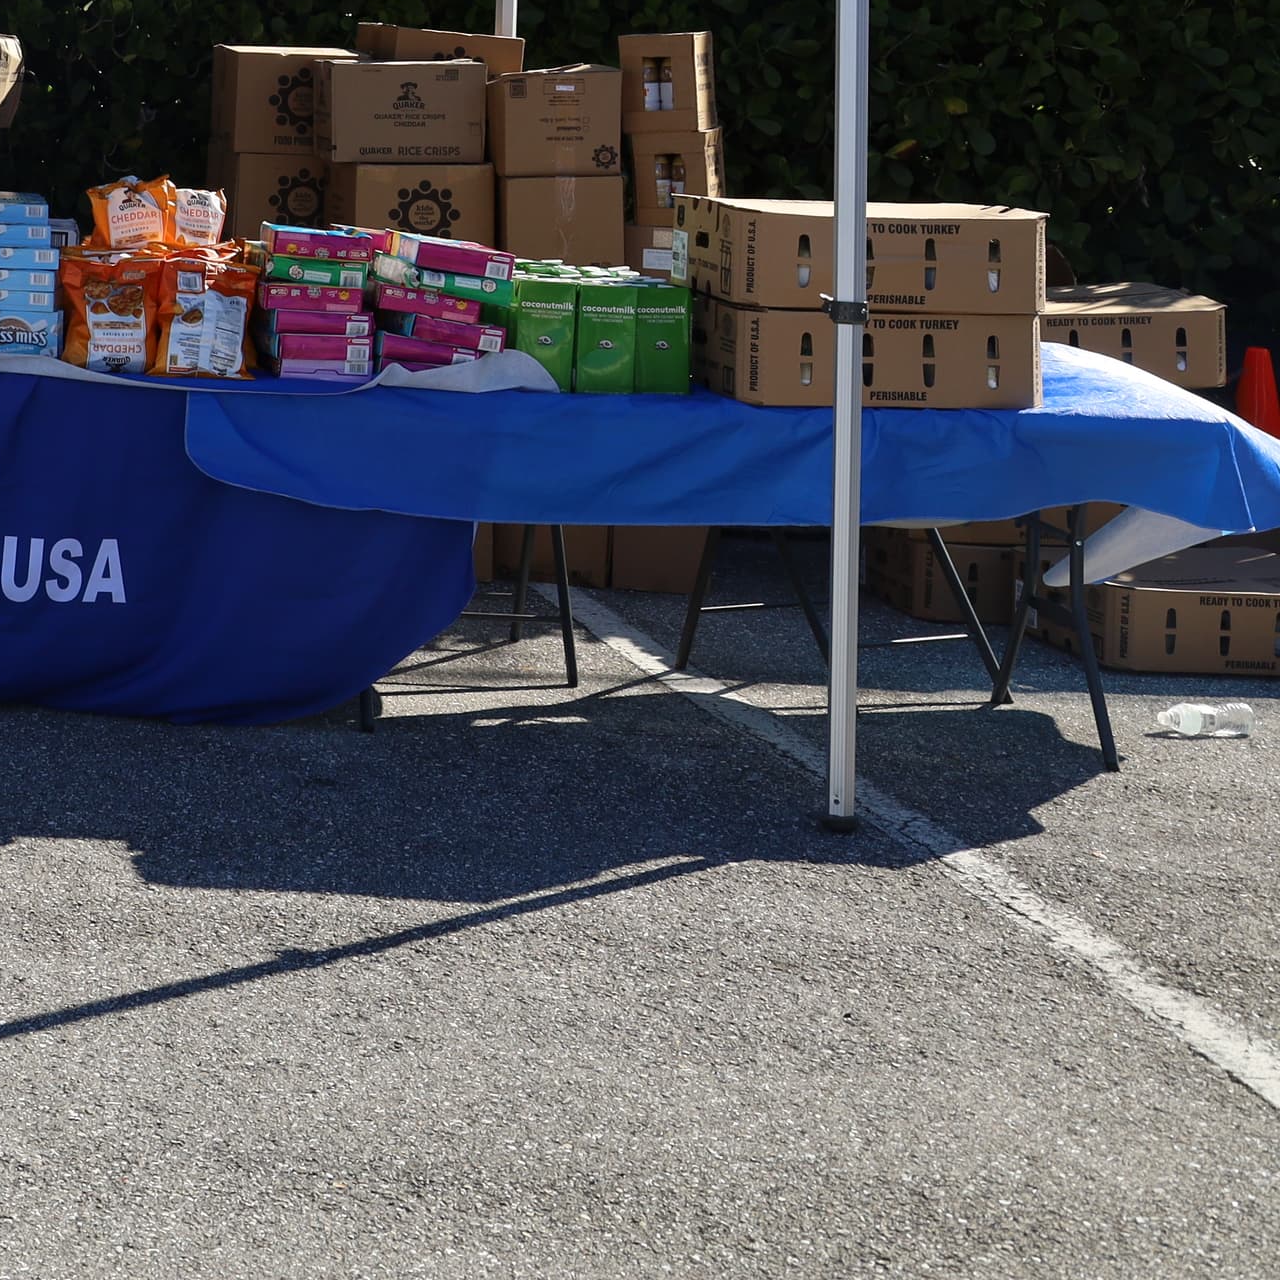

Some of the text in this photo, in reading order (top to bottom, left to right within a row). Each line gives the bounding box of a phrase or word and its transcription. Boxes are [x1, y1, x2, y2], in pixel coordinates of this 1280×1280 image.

[392, 100, 426, 111] QUAKER
[359, 146, 461, 156] QUAKER RICE CRISPS
[111, 211, 158, 224] CHEDDAR
[872, 223, 961, 235] TO COOK TURKEY
[747, 246, 756, 258] OF
[746, 259, 756, 293] PRODUCT
[521, 300, 574, 311] coconutmilk
[867, 294, 926, 305] PERISHABLE
[582, 305, 635, 315] coconutmilk
[637, 306, 686, 315] coconutmilk
[874, 319, 885, 329] TO
[888, 319, 917, 329] COOK
[920, 319, 960, 330] TURKEY
[1046, 315, 1153, 327] READY TO COOK TURKEY
[93, 344, 142, 356] CHEDDAR
[750, 342, 758, 356] OF
[749, 358, 758, 393] PRODUCT
[869, 390, 927, 401] PERISHABLE
[1, 534, 127, 604] USA
[1199, 596, 1229, 607] READY
[1232, 597, 1243, 607] TO
[1246, 598, 1271, 608] COOK
